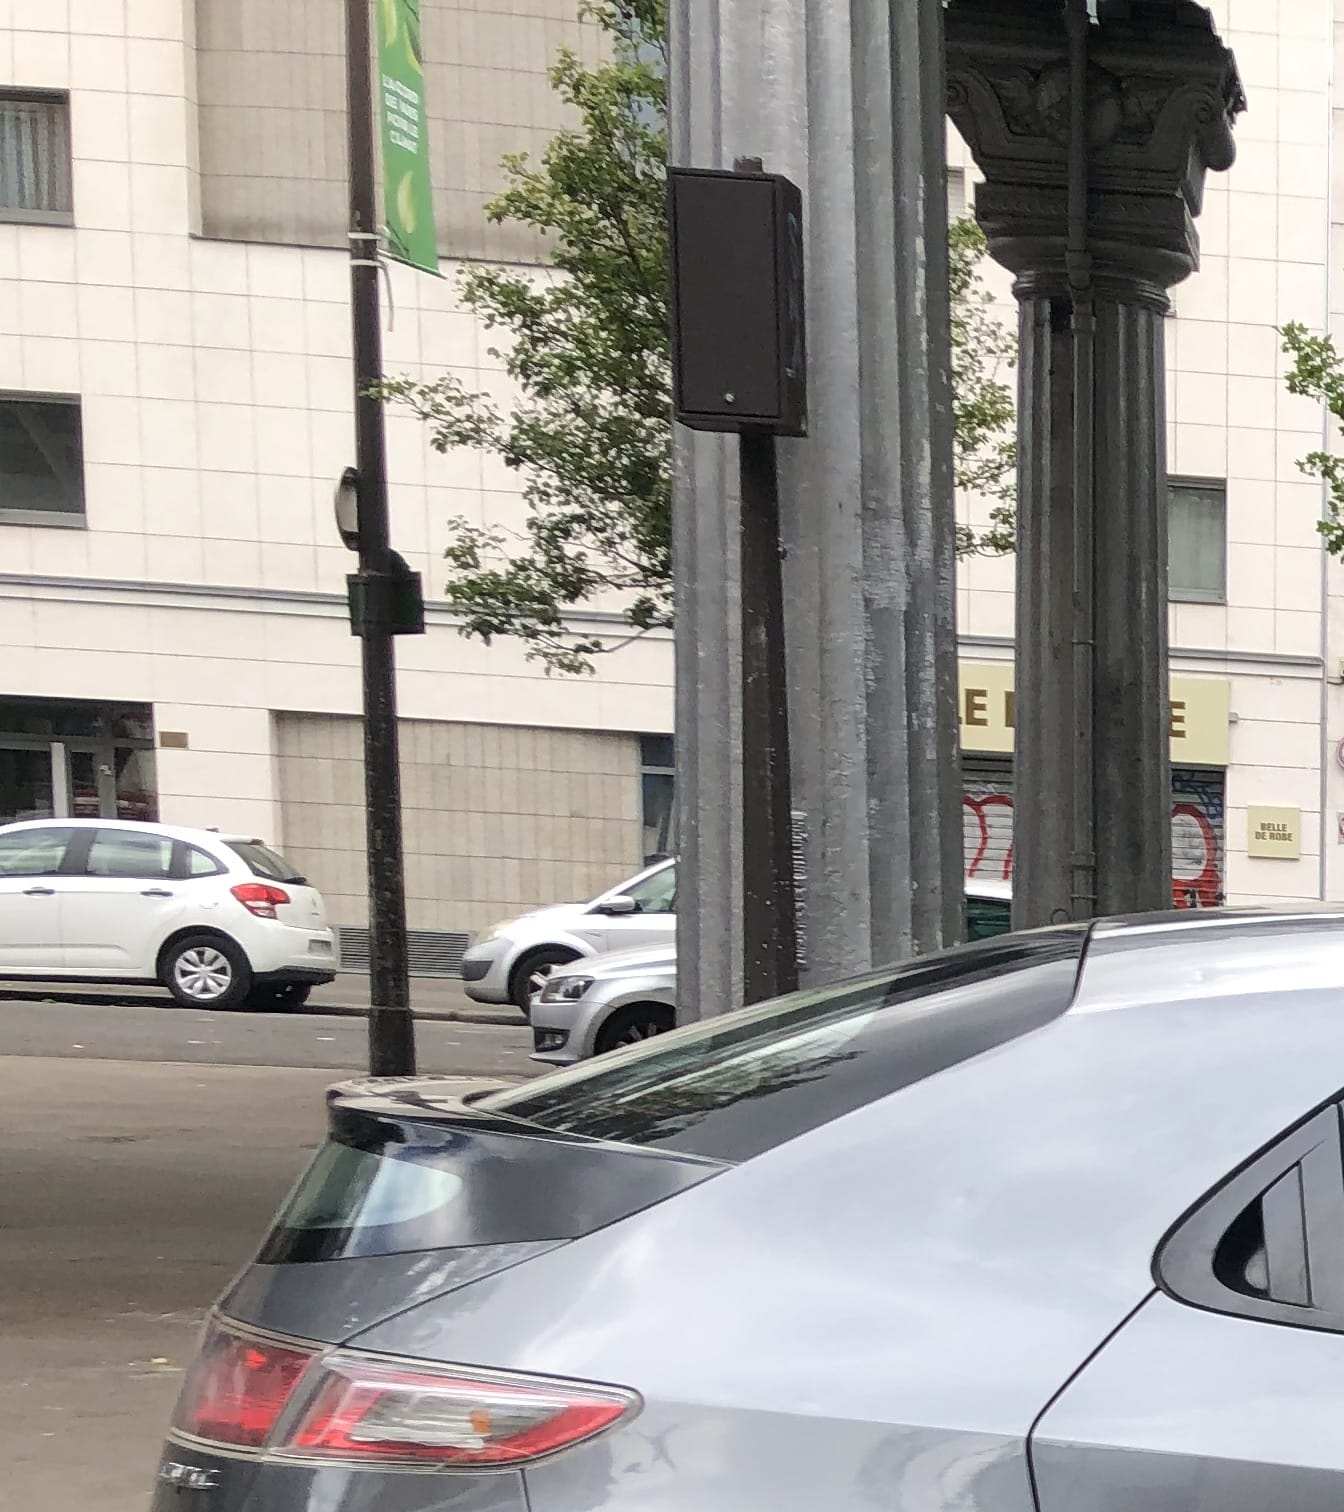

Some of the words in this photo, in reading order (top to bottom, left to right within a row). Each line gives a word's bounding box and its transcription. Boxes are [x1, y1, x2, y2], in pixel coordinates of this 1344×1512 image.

[1260, 822, 1288, 832] BELLE
[1255, 831, 1267, 841] DE
[1269, 831, 1293, 842] ROBE
